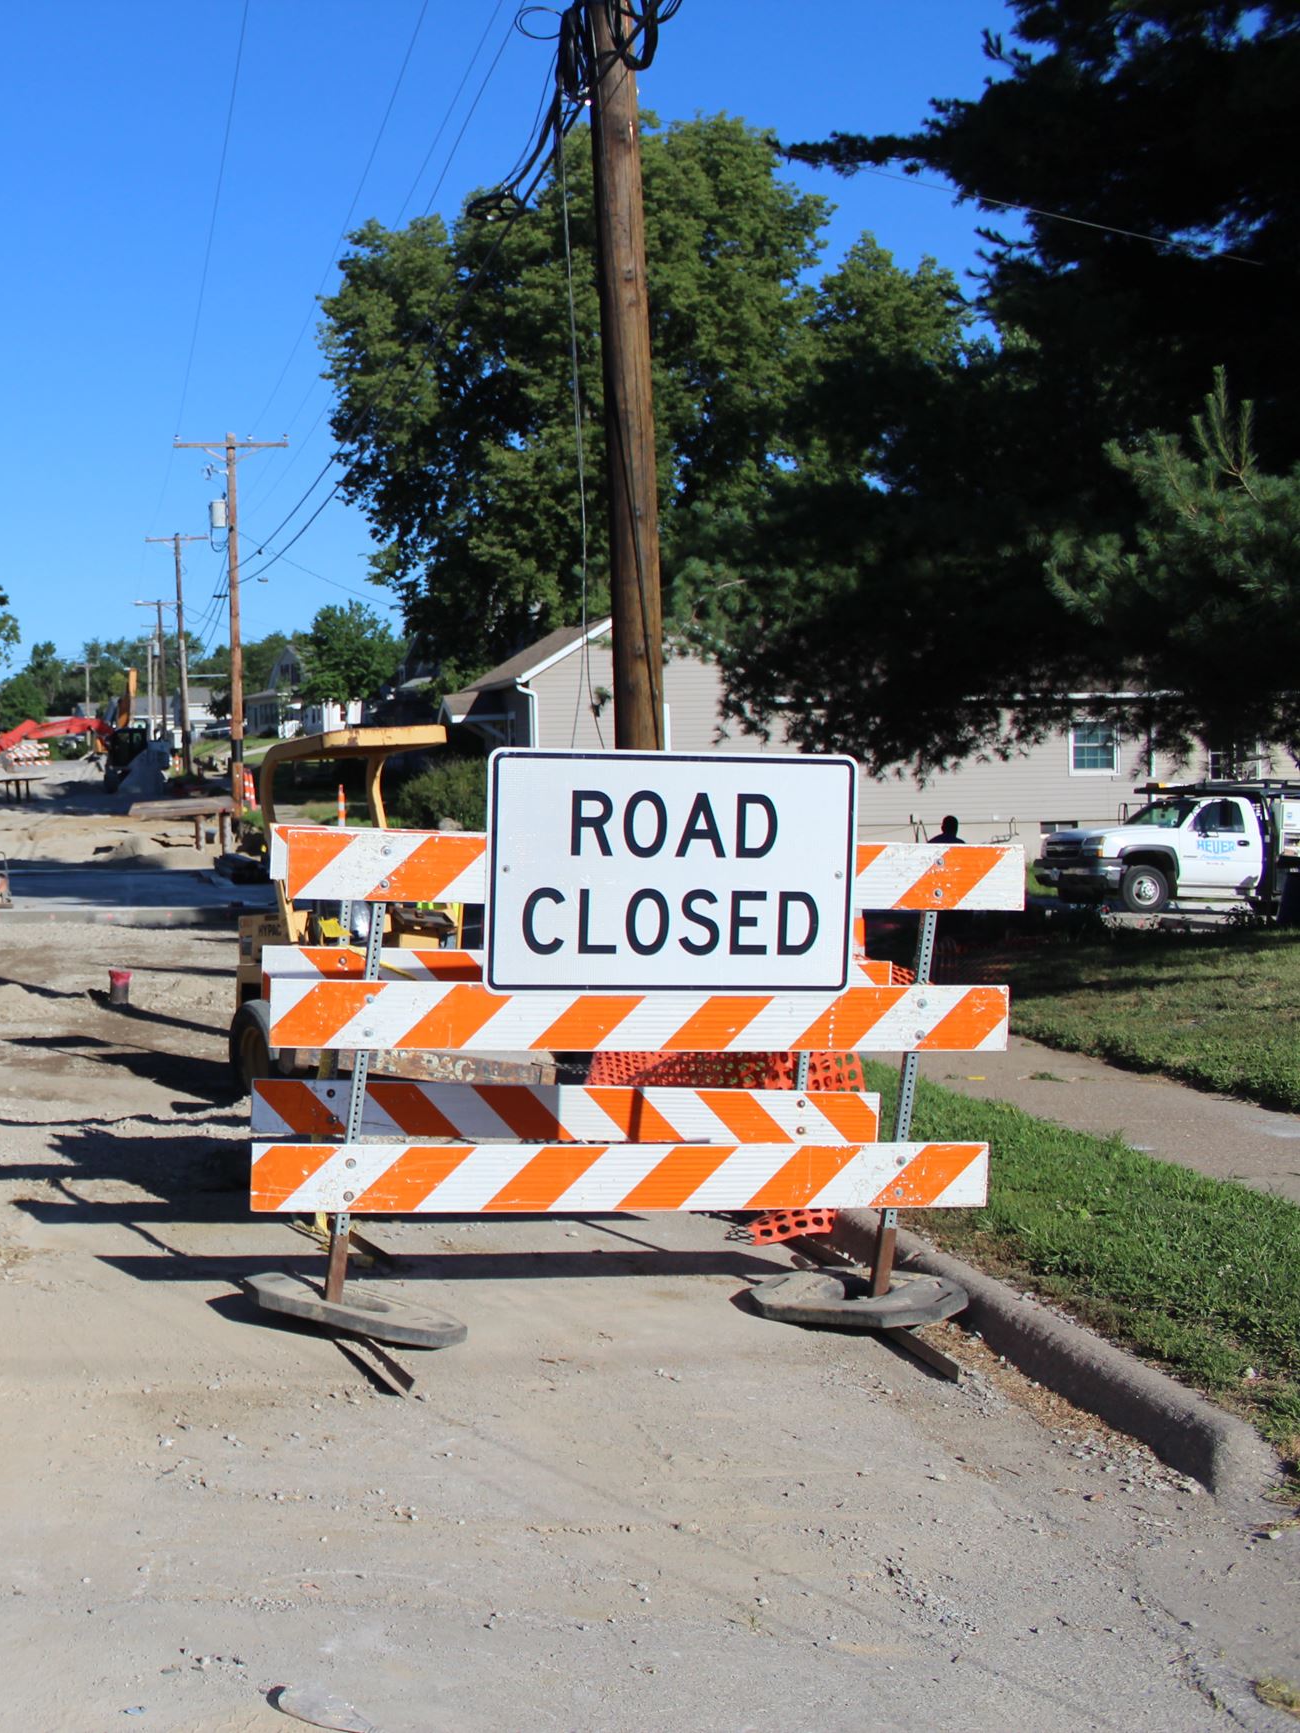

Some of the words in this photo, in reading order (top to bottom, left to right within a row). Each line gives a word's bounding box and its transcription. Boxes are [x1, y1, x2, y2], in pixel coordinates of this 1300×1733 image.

[570, 790, 778, 858] ROAD
[1197, 839, 1235, 854] HEUER
[522, 887, 819, 956] CLOSED
